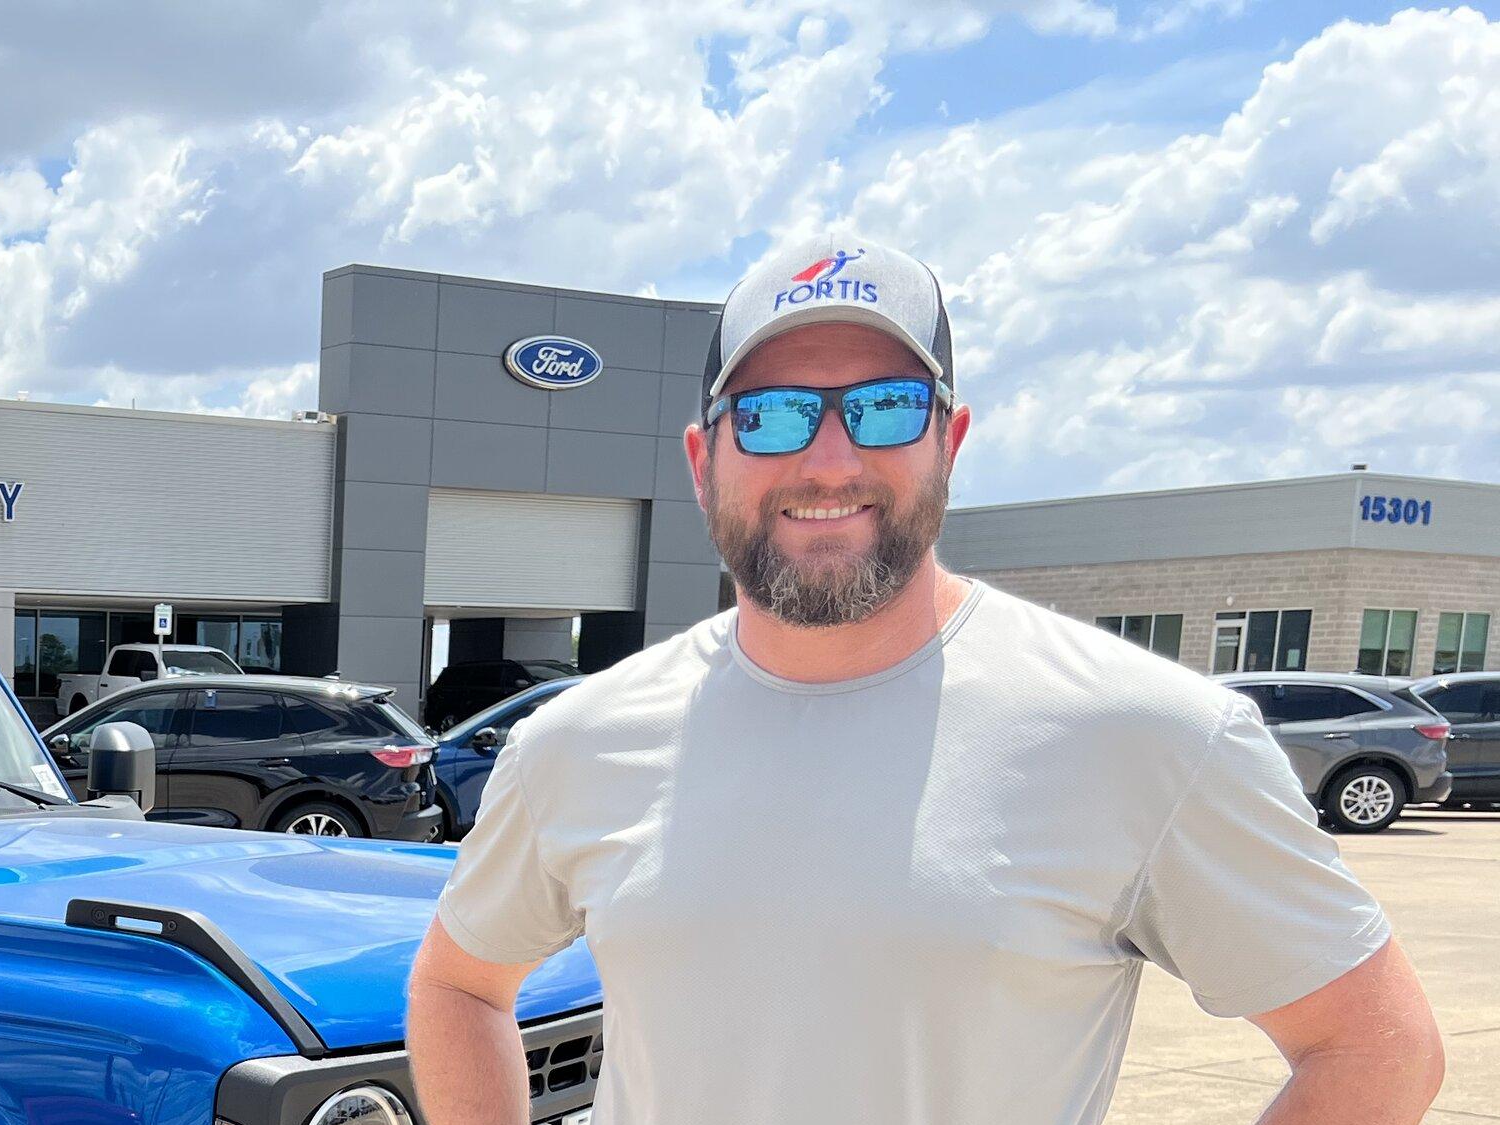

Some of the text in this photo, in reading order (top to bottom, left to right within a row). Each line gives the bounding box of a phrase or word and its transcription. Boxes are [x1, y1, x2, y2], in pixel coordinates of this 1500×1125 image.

[773, 280, 878, 312] FORTIS
[532, 346, 584, 378] Ford
[1360, 495, 1432, 526] 15301
